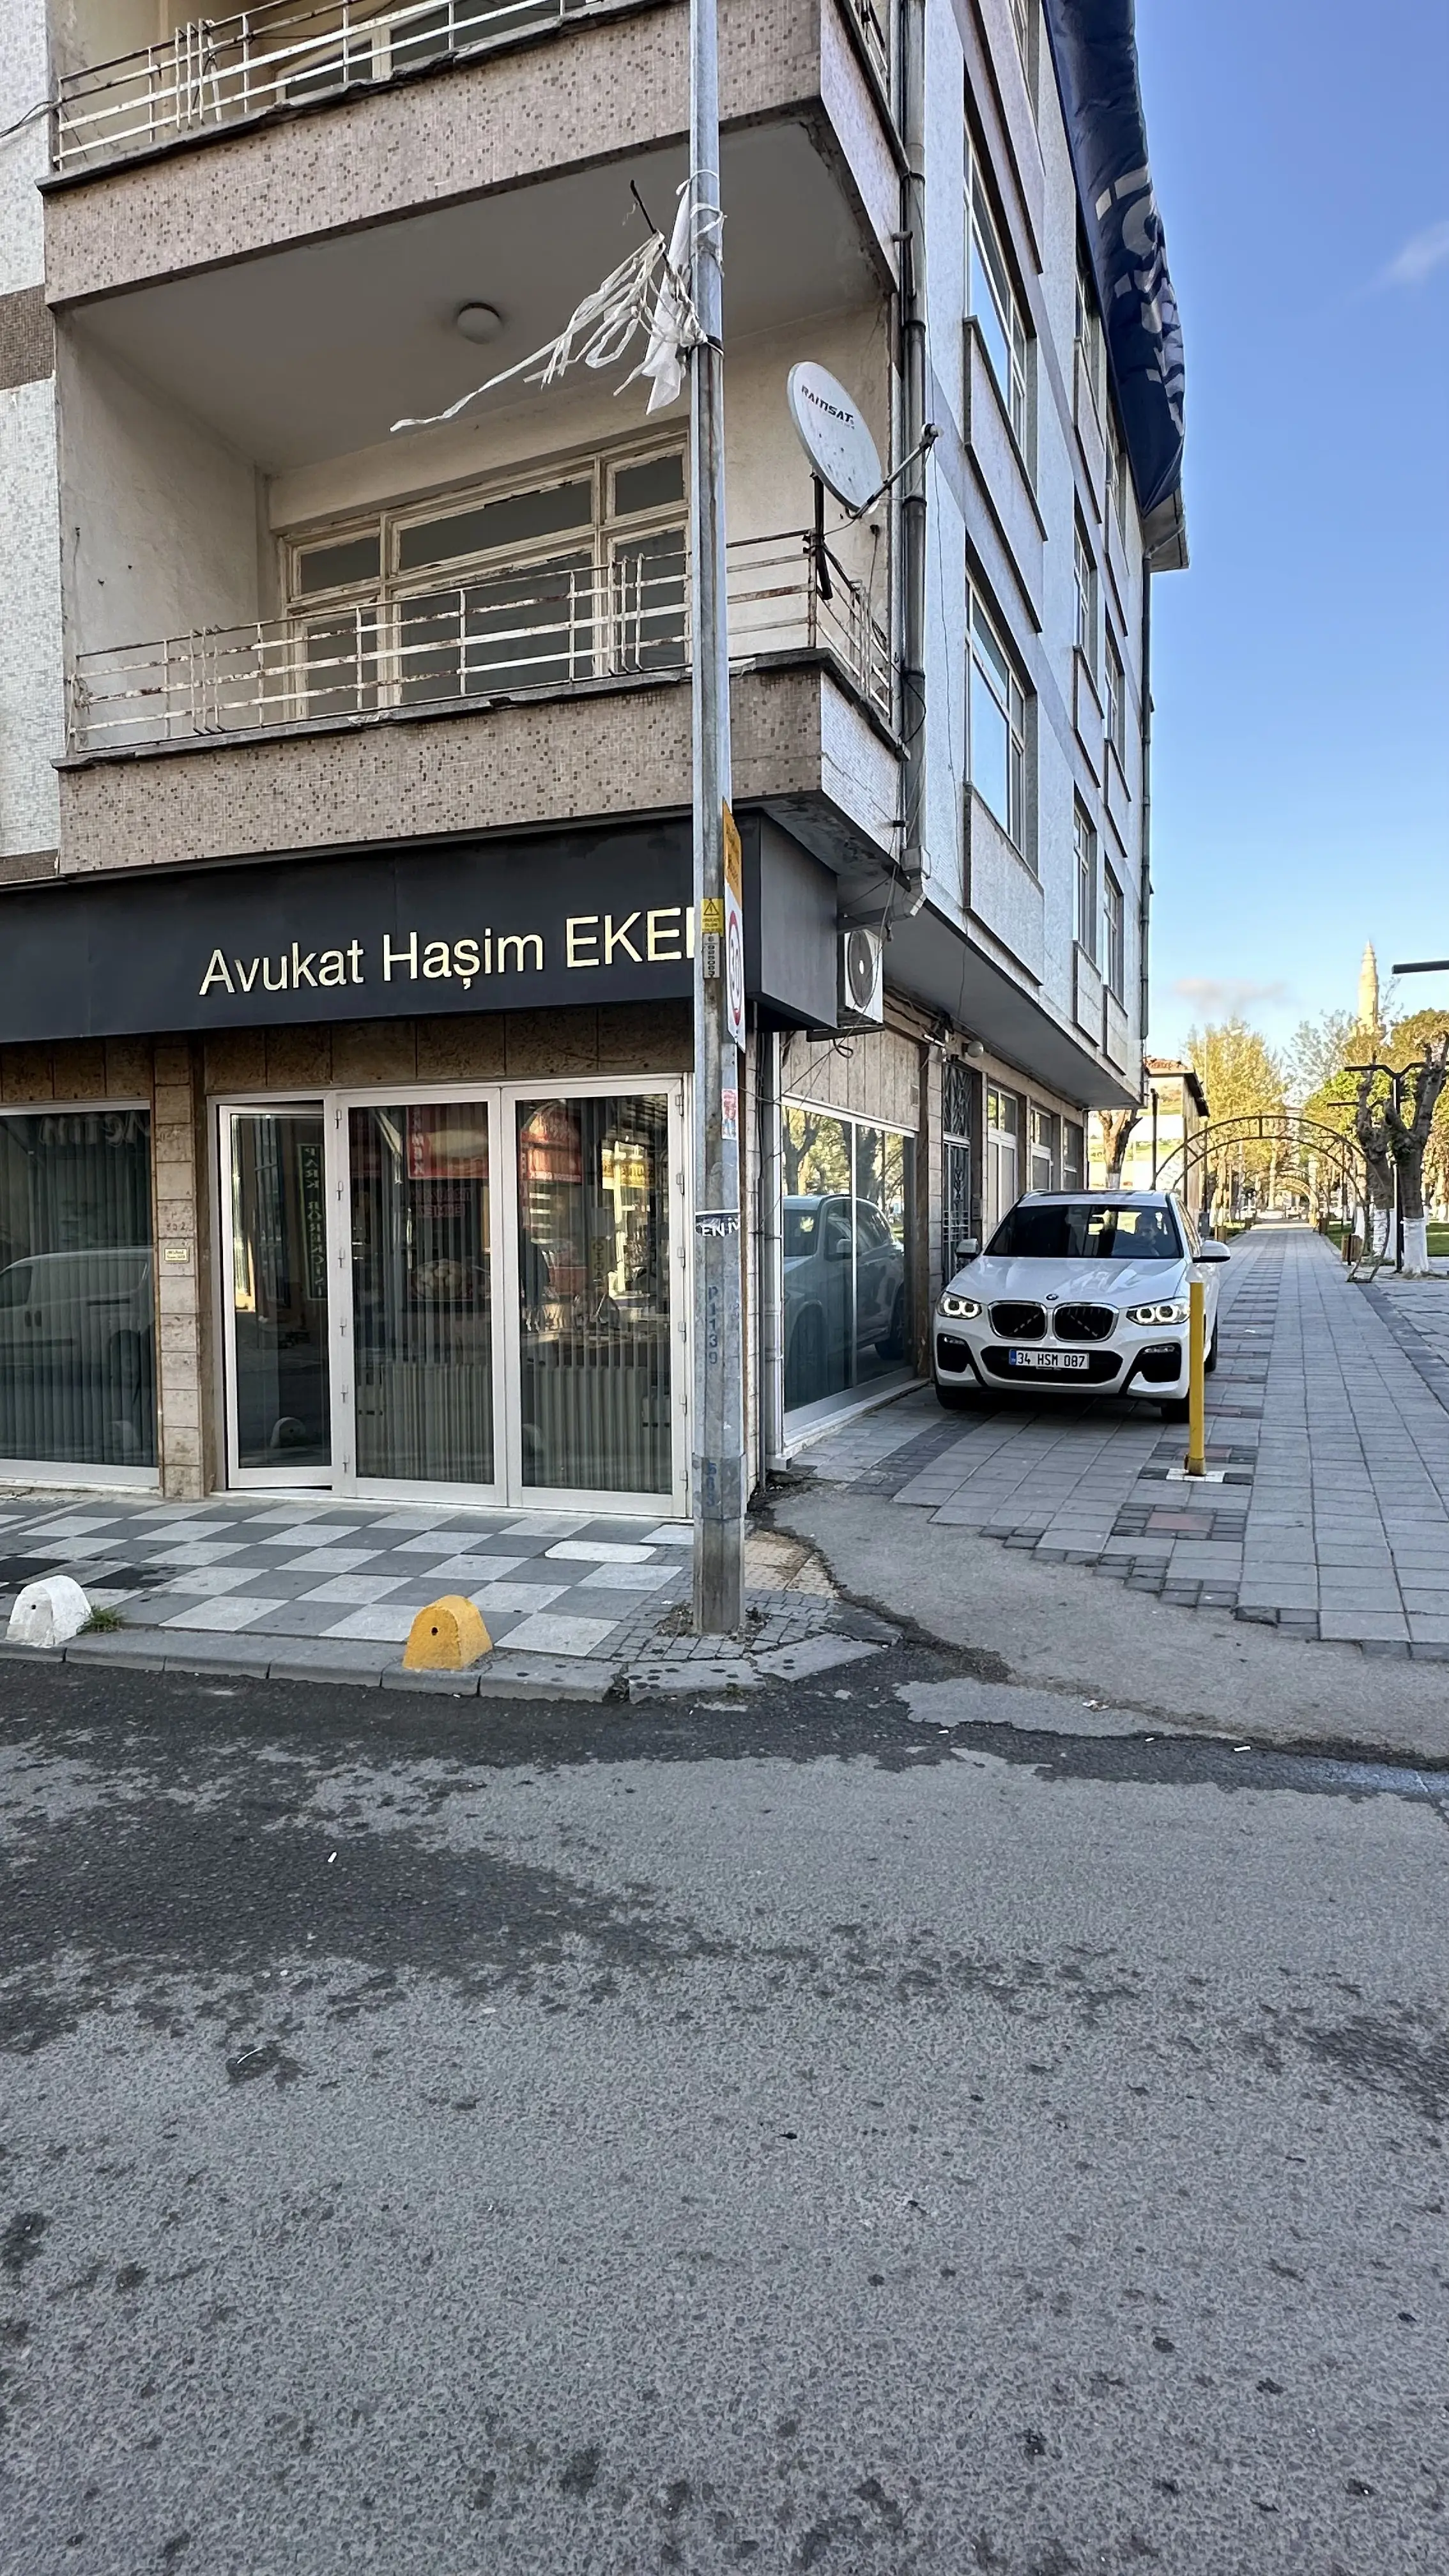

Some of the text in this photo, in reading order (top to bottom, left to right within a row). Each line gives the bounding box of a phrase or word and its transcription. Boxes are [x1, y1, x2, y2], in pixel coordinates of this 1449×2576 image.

[199, 940, 365, 996] Avukat
[383, 928, 543, 990] Haşim
[1018, 1352, 1085, 1367] 34 HSM 087
